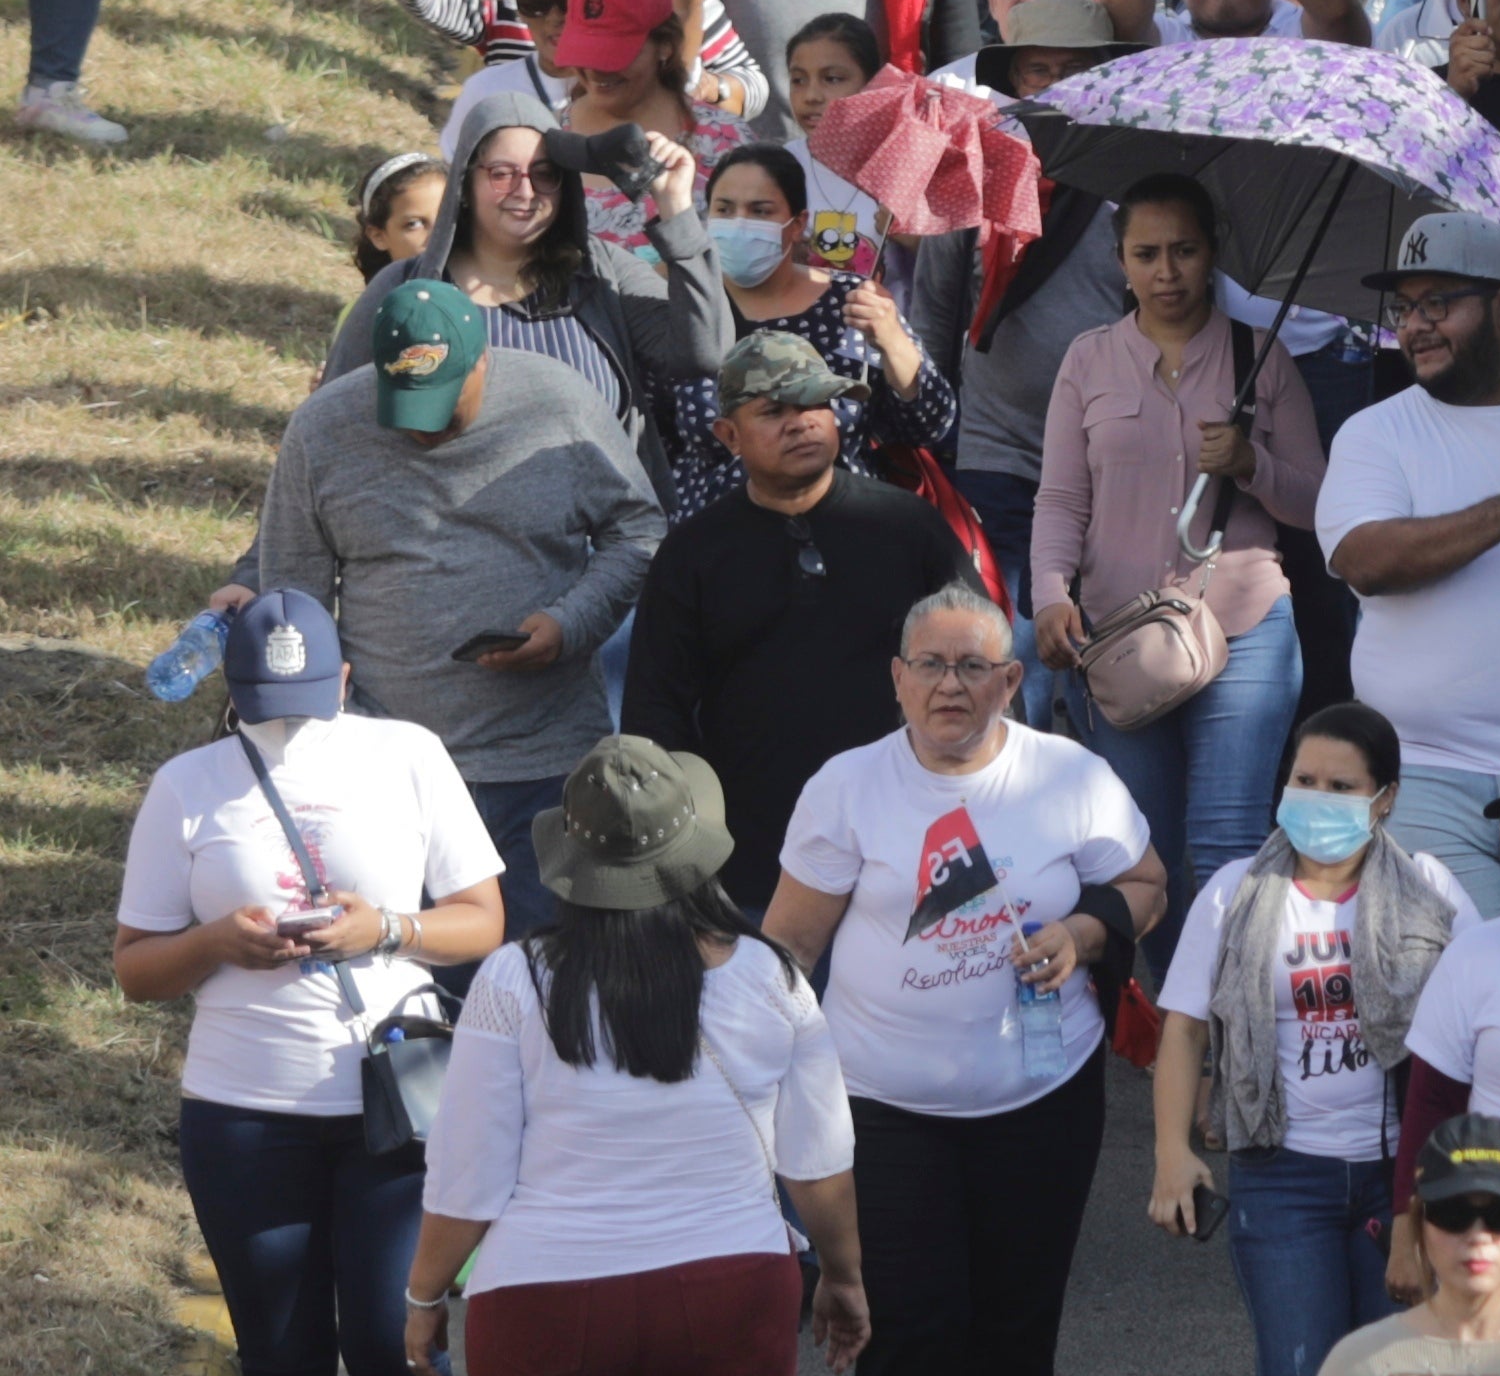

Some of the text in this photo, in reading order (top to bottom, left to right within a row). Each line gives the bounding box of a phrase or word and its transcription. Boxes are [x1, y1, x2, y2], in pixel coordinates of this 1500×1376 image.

[936, 932, 998, 953] NUESTRAS
[948, 943, 988, 961] VOCES
[900, 943, 1012, 991] Revolució
